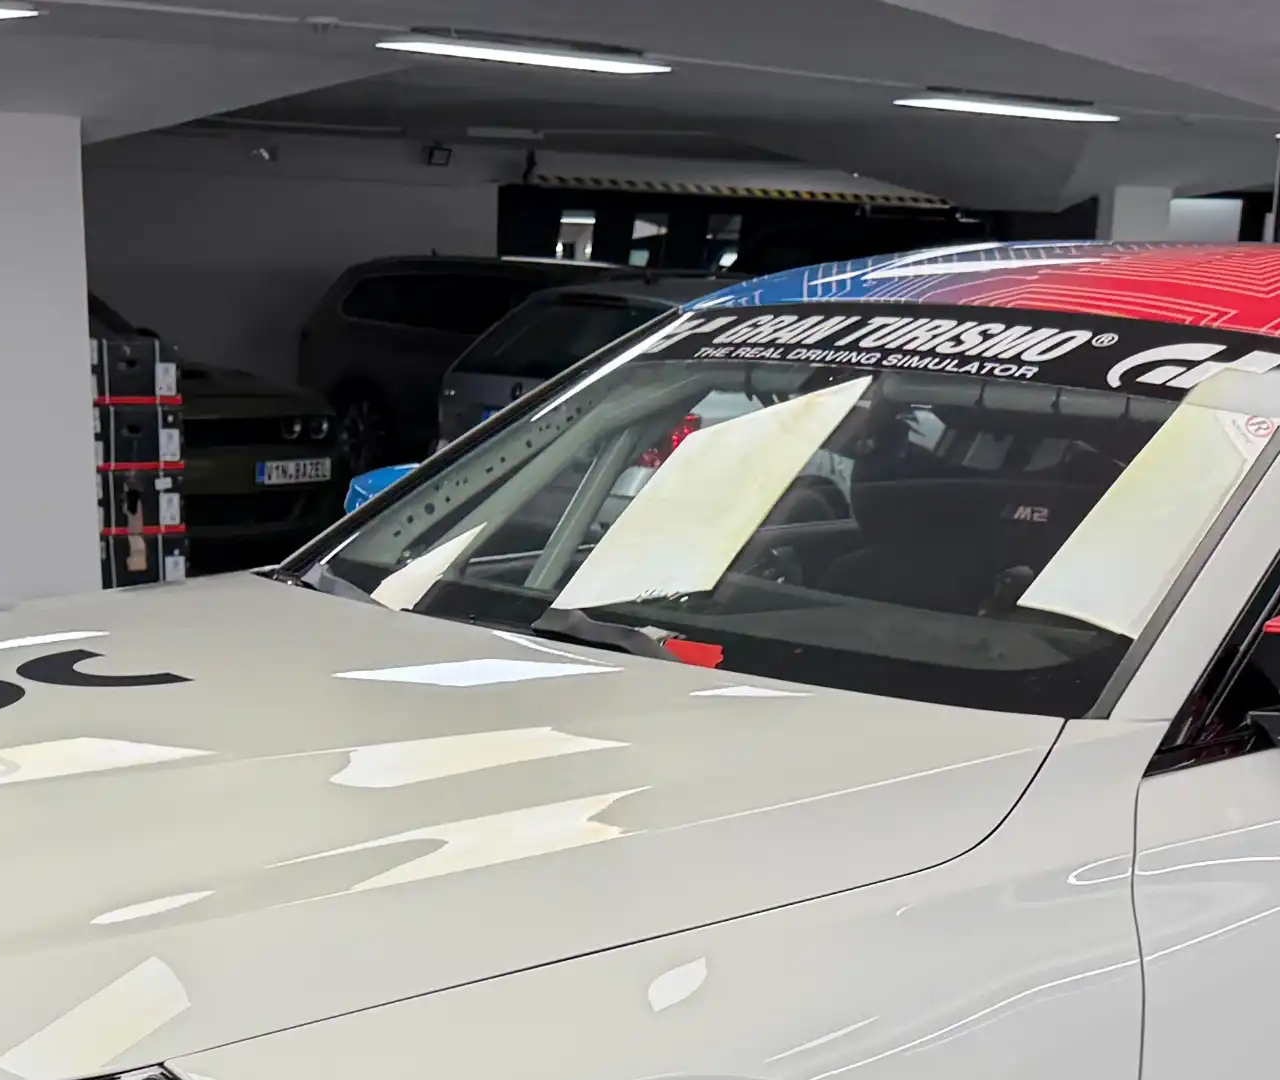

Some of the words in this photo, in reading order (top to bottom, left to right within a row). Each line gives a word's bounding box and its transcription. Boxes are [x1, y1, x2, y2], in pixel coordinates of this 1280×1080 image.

[712, 315, 862, 345] GRAN
[693, 346, 735, 359] THE
[731, 347, 781, 359] REAL
[785, 348, 881, 364] DRIVING
[881, 353, 1040, 379] SIMULATOR
